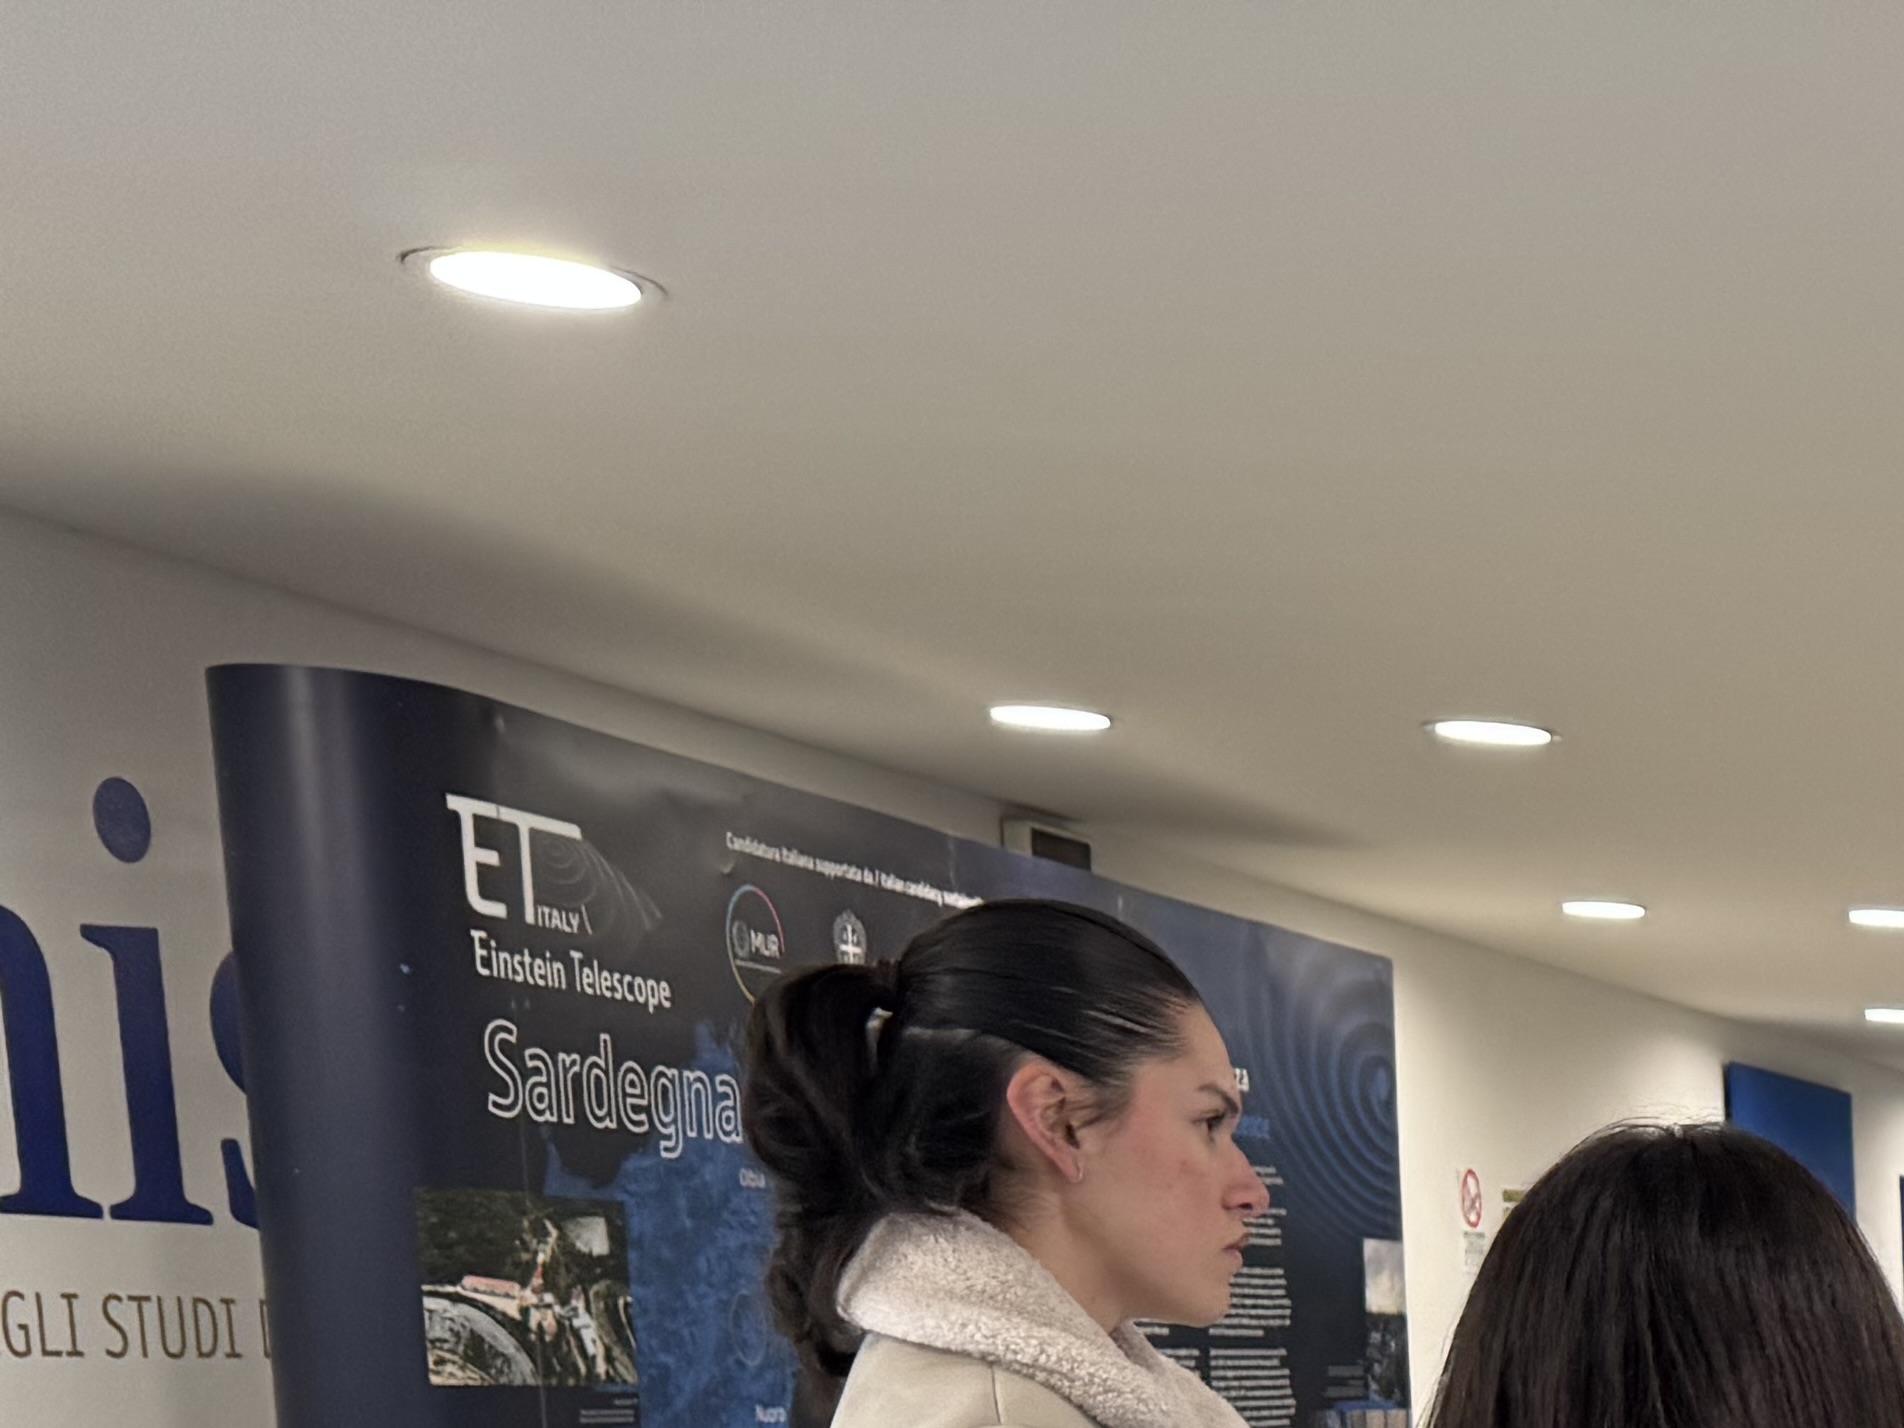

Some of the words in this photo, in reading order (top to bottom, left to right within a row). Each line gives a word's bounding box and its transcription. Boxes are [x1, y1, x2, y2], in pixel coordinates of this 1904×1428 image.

[446, 793, 583, 925] ET
[537, 905, 580, 934] ITALY
[751, 928, 779, 958] MUR
[470, 929, 566, 989] Einstein
[569, 950, 672, 1014] Telescope
[484, 1018, 743, 1160] Sardegna
[101, 1293, 242, 1358] STUDI
